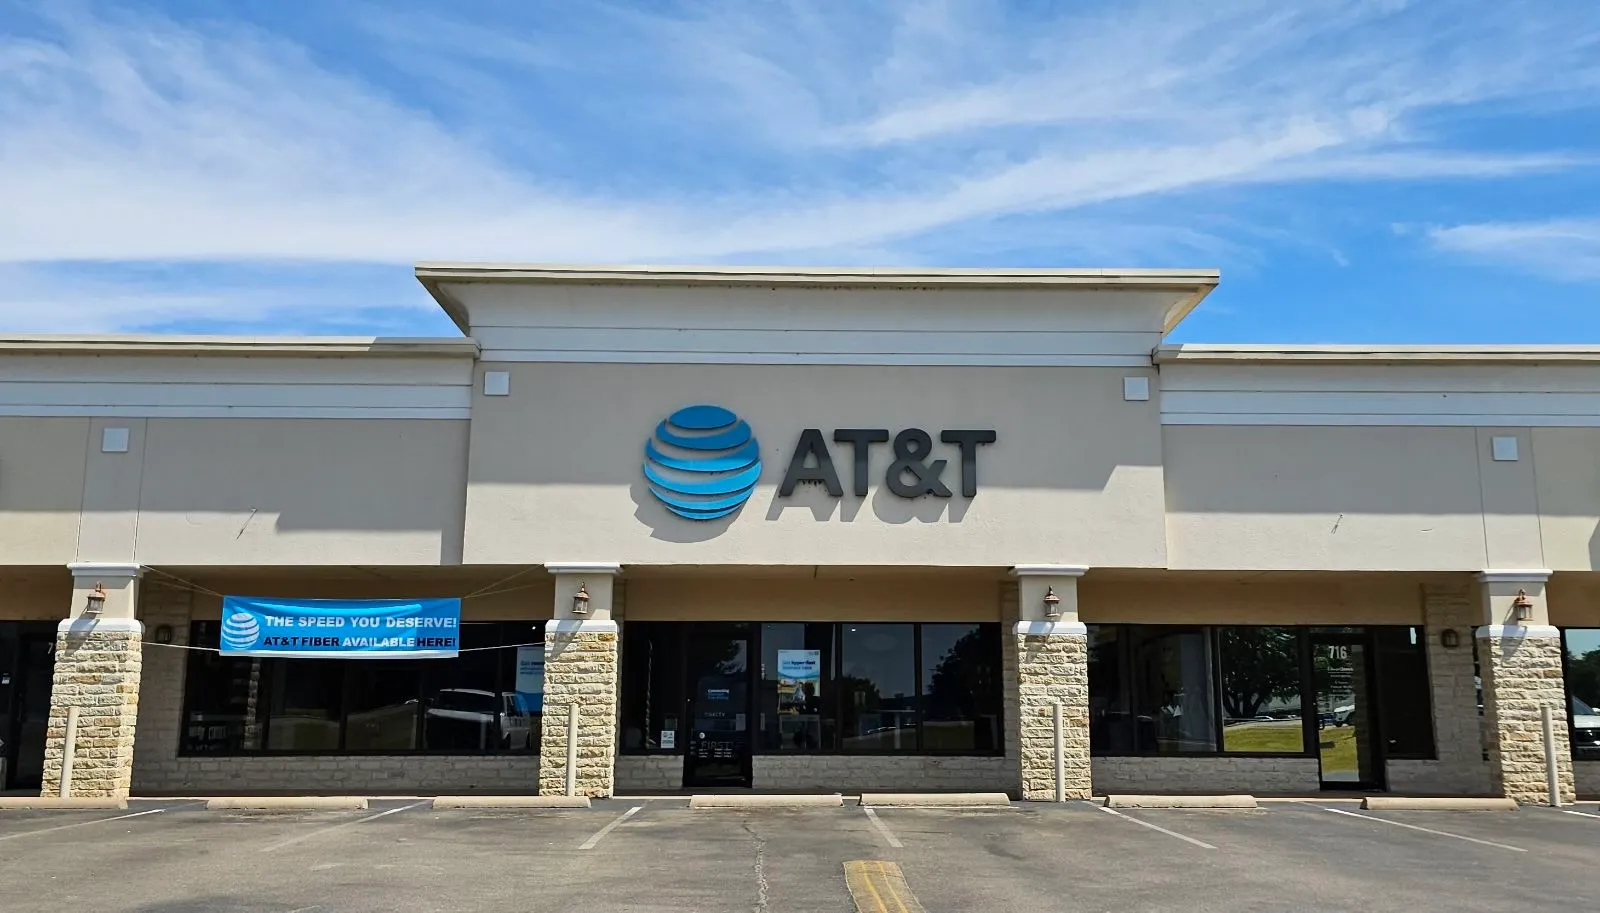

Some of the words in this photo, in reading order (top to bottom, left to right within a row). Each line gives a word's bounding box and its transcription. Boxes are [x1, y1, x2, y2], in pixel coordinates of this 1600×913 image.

[779, 428, 996, 498] AT&T
[264, 615, 294, 627] THE
[298, 616, 345, 628] SPEED
[350, 617, 380, 628] YOU
[386, 617, 457, 628] DESERVE!
[264, 636, 299, 647] AT&T
[302, 636, 340, 647] FIBER
[342, 637, 415, 647] AVAILABLE
[417, 637, 456, 647] HERE!
[1328, 645, 1347, 659] 716
